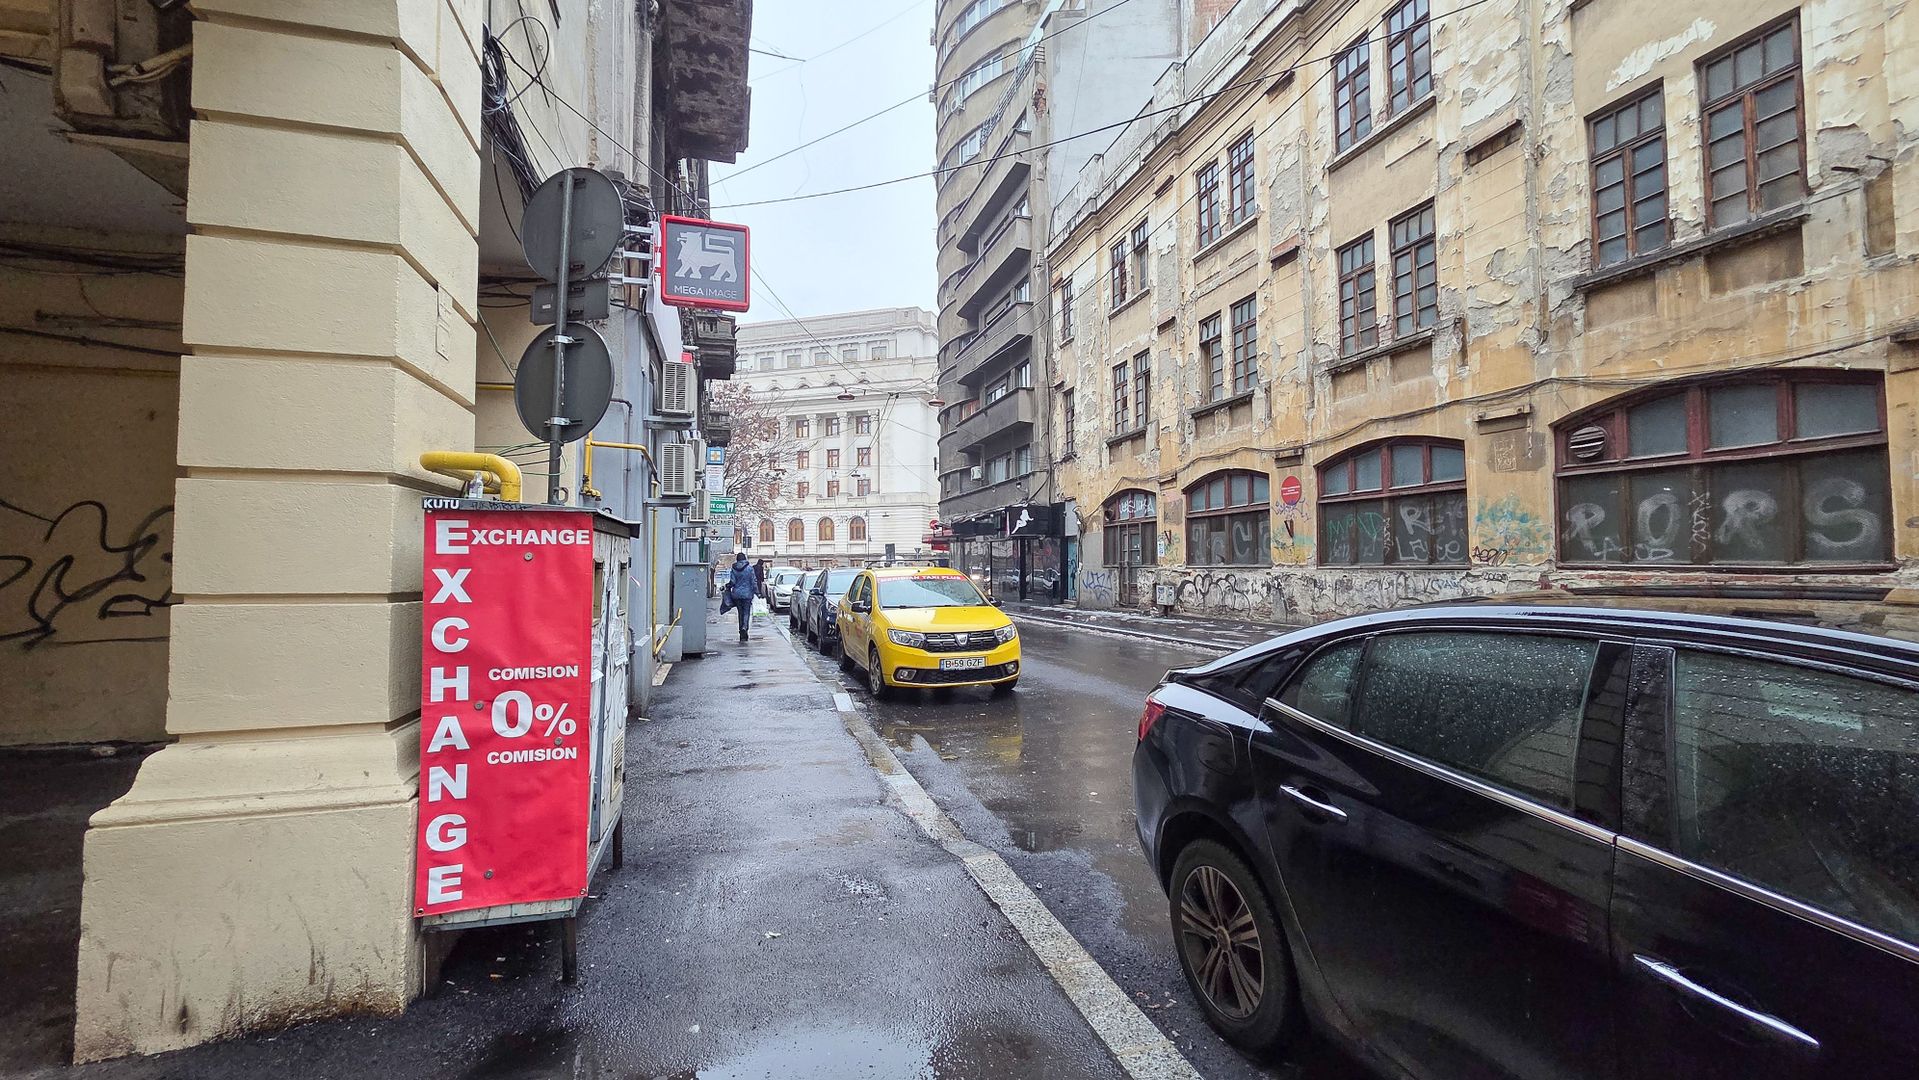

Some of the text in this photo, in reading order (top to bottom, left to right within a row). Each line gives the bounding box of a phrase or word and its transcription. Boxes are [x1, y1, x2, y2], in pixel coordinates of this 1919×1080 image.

[674, 285, 737, 299] MEGA IMAGE
[423, 498, 459, 509] KUTU
[435, 519, 591, 555] EXCHANGE
[945, 658, 983, 668] B 59 GZF
[488, 665, 580, 681] COMISION
[490, 690, 578, 739] 0%
[487, 746, 578, 765] COMISION
